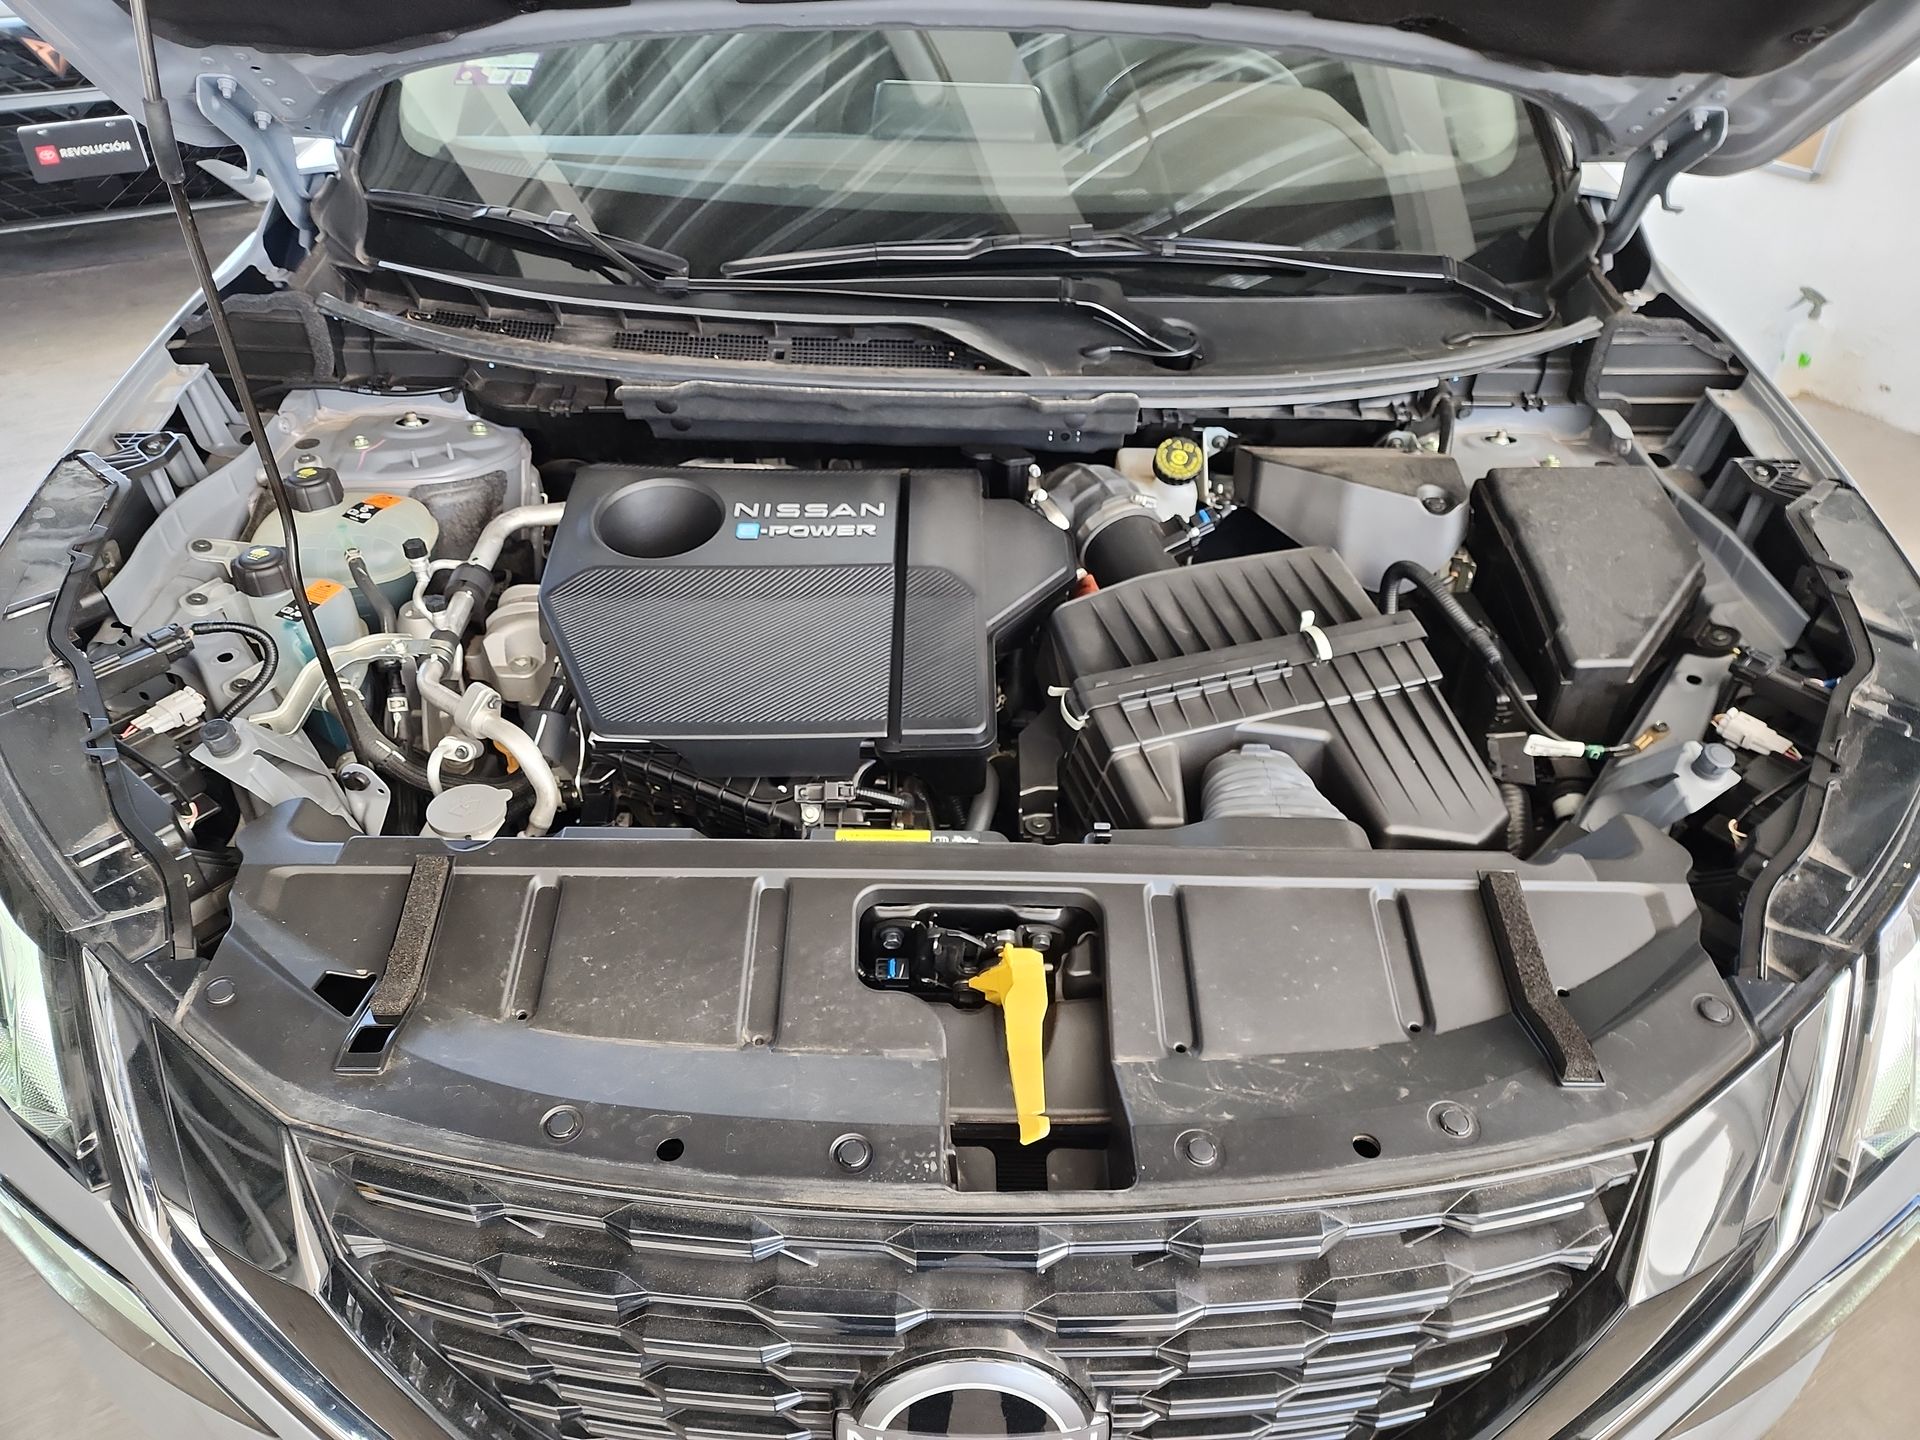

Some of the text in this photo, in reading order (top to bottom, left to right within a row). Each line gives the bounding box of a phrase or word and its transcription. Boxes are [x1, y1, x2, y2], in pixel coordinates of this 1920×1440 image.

[60, 140, 131, 158] REVOLUCIÓN
[733, 502, 886, 518] NISSAN
[183, 873, 196, 888] 2
